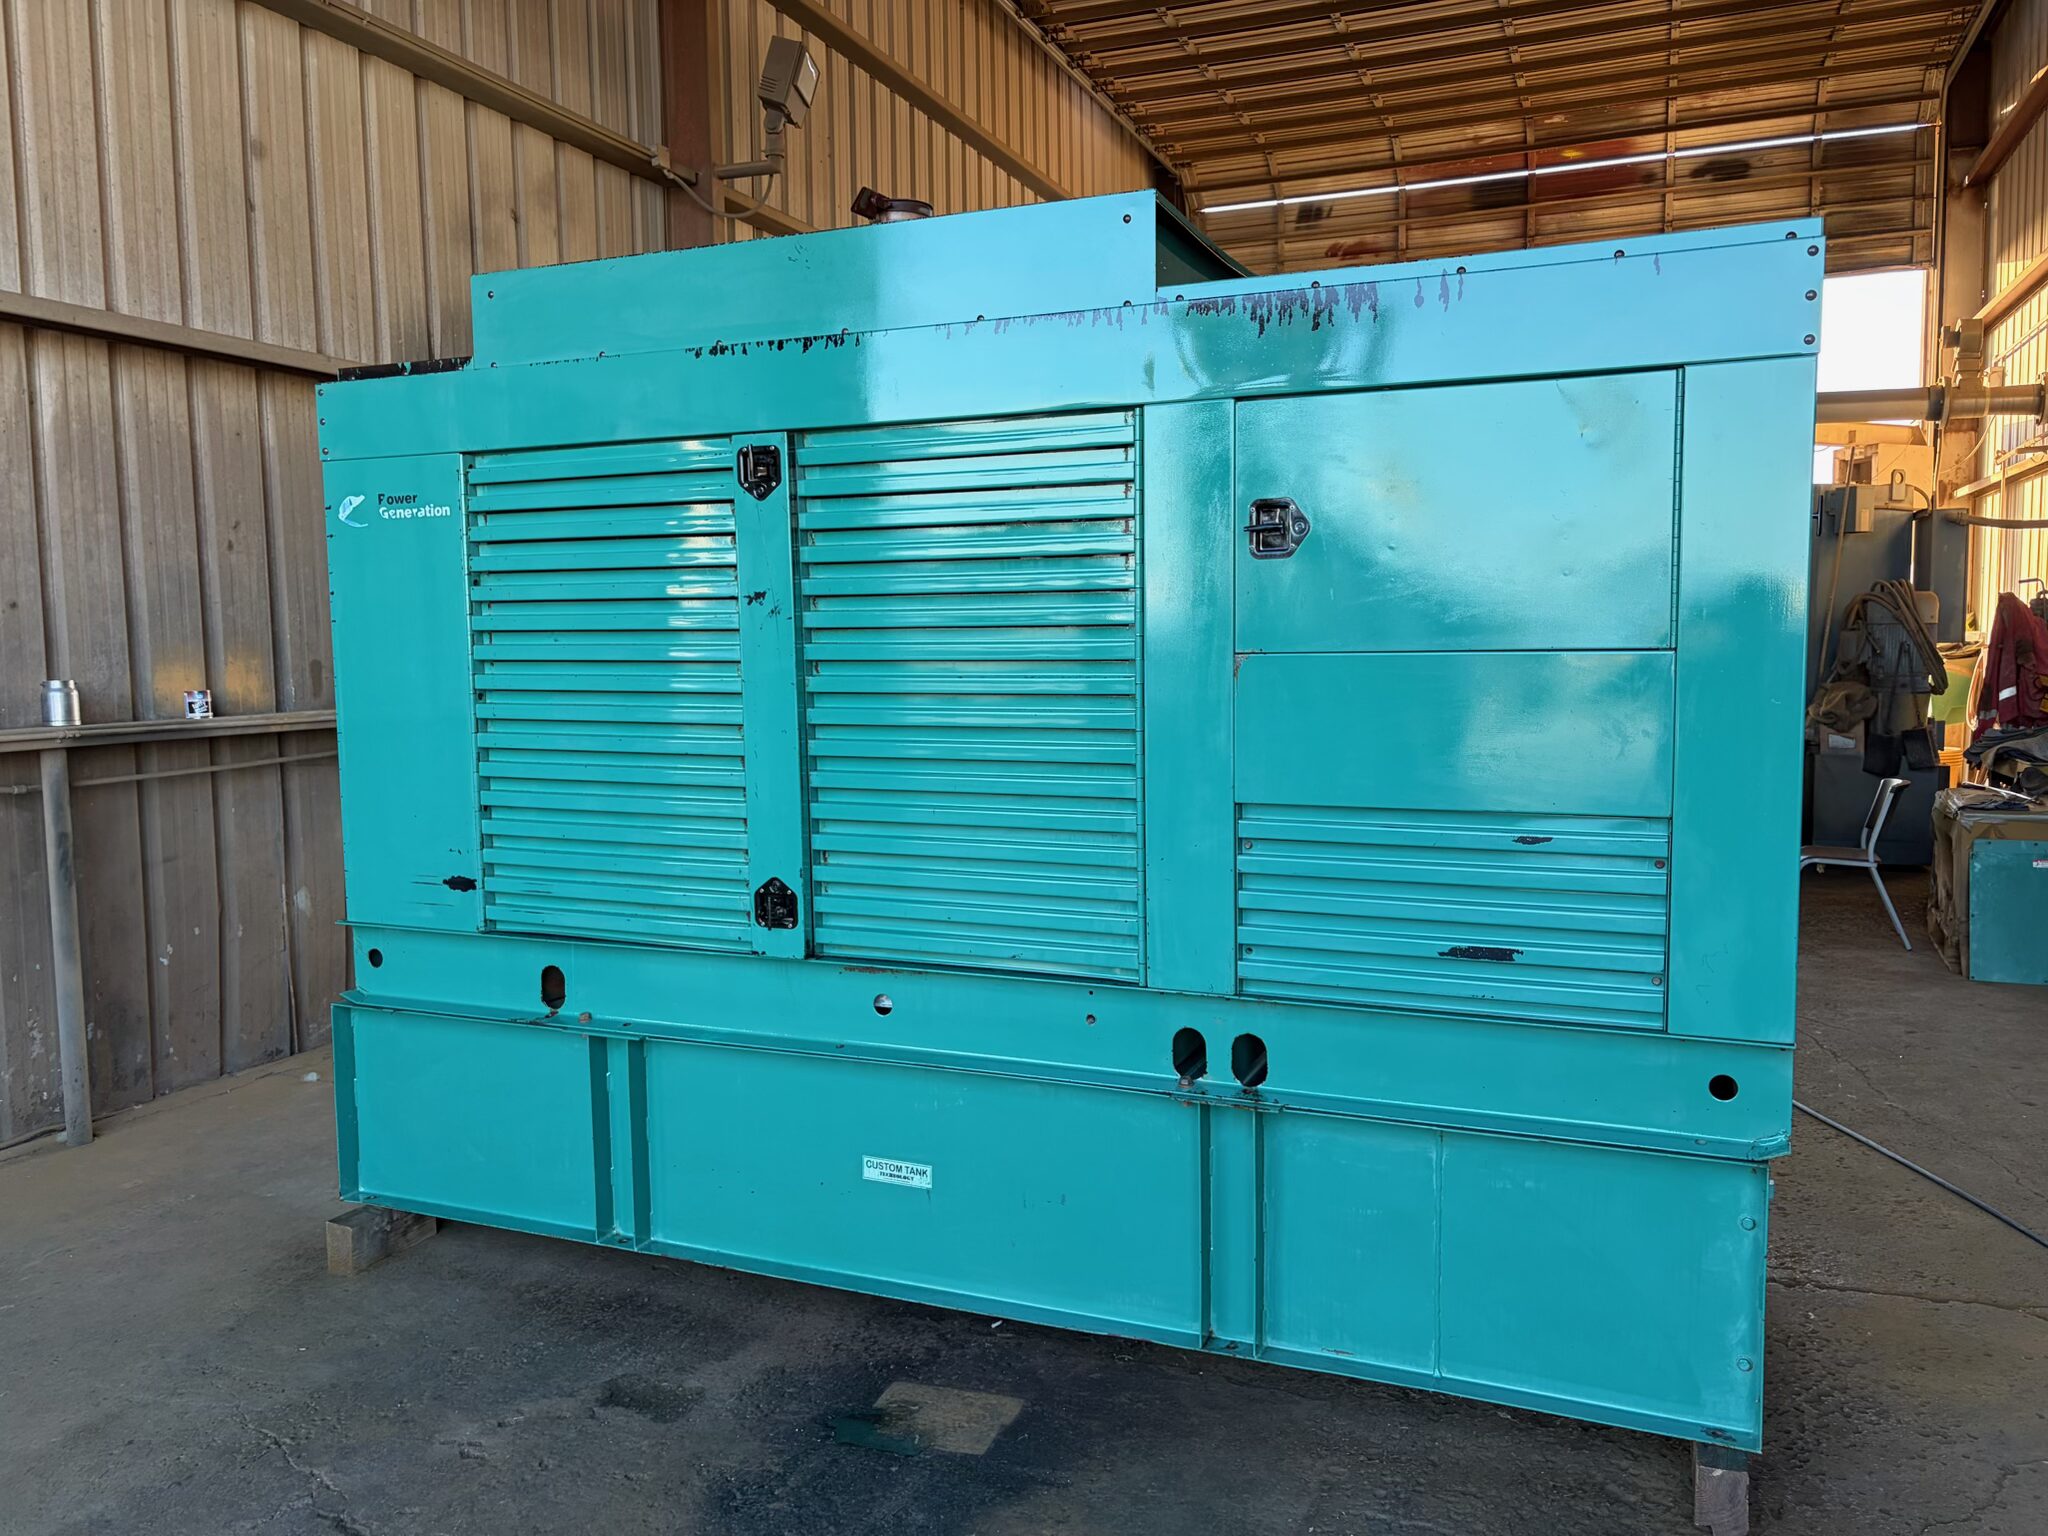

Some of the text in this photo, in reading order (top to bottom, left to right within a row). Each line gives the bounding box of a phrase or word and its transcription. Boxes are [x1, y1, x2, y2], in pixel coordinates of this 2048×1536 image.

[378, 493, 418, 505] Power
[379, 504, 451, 519] Generation
[866, 1160, 928, 1178] CUSTOM TANK
